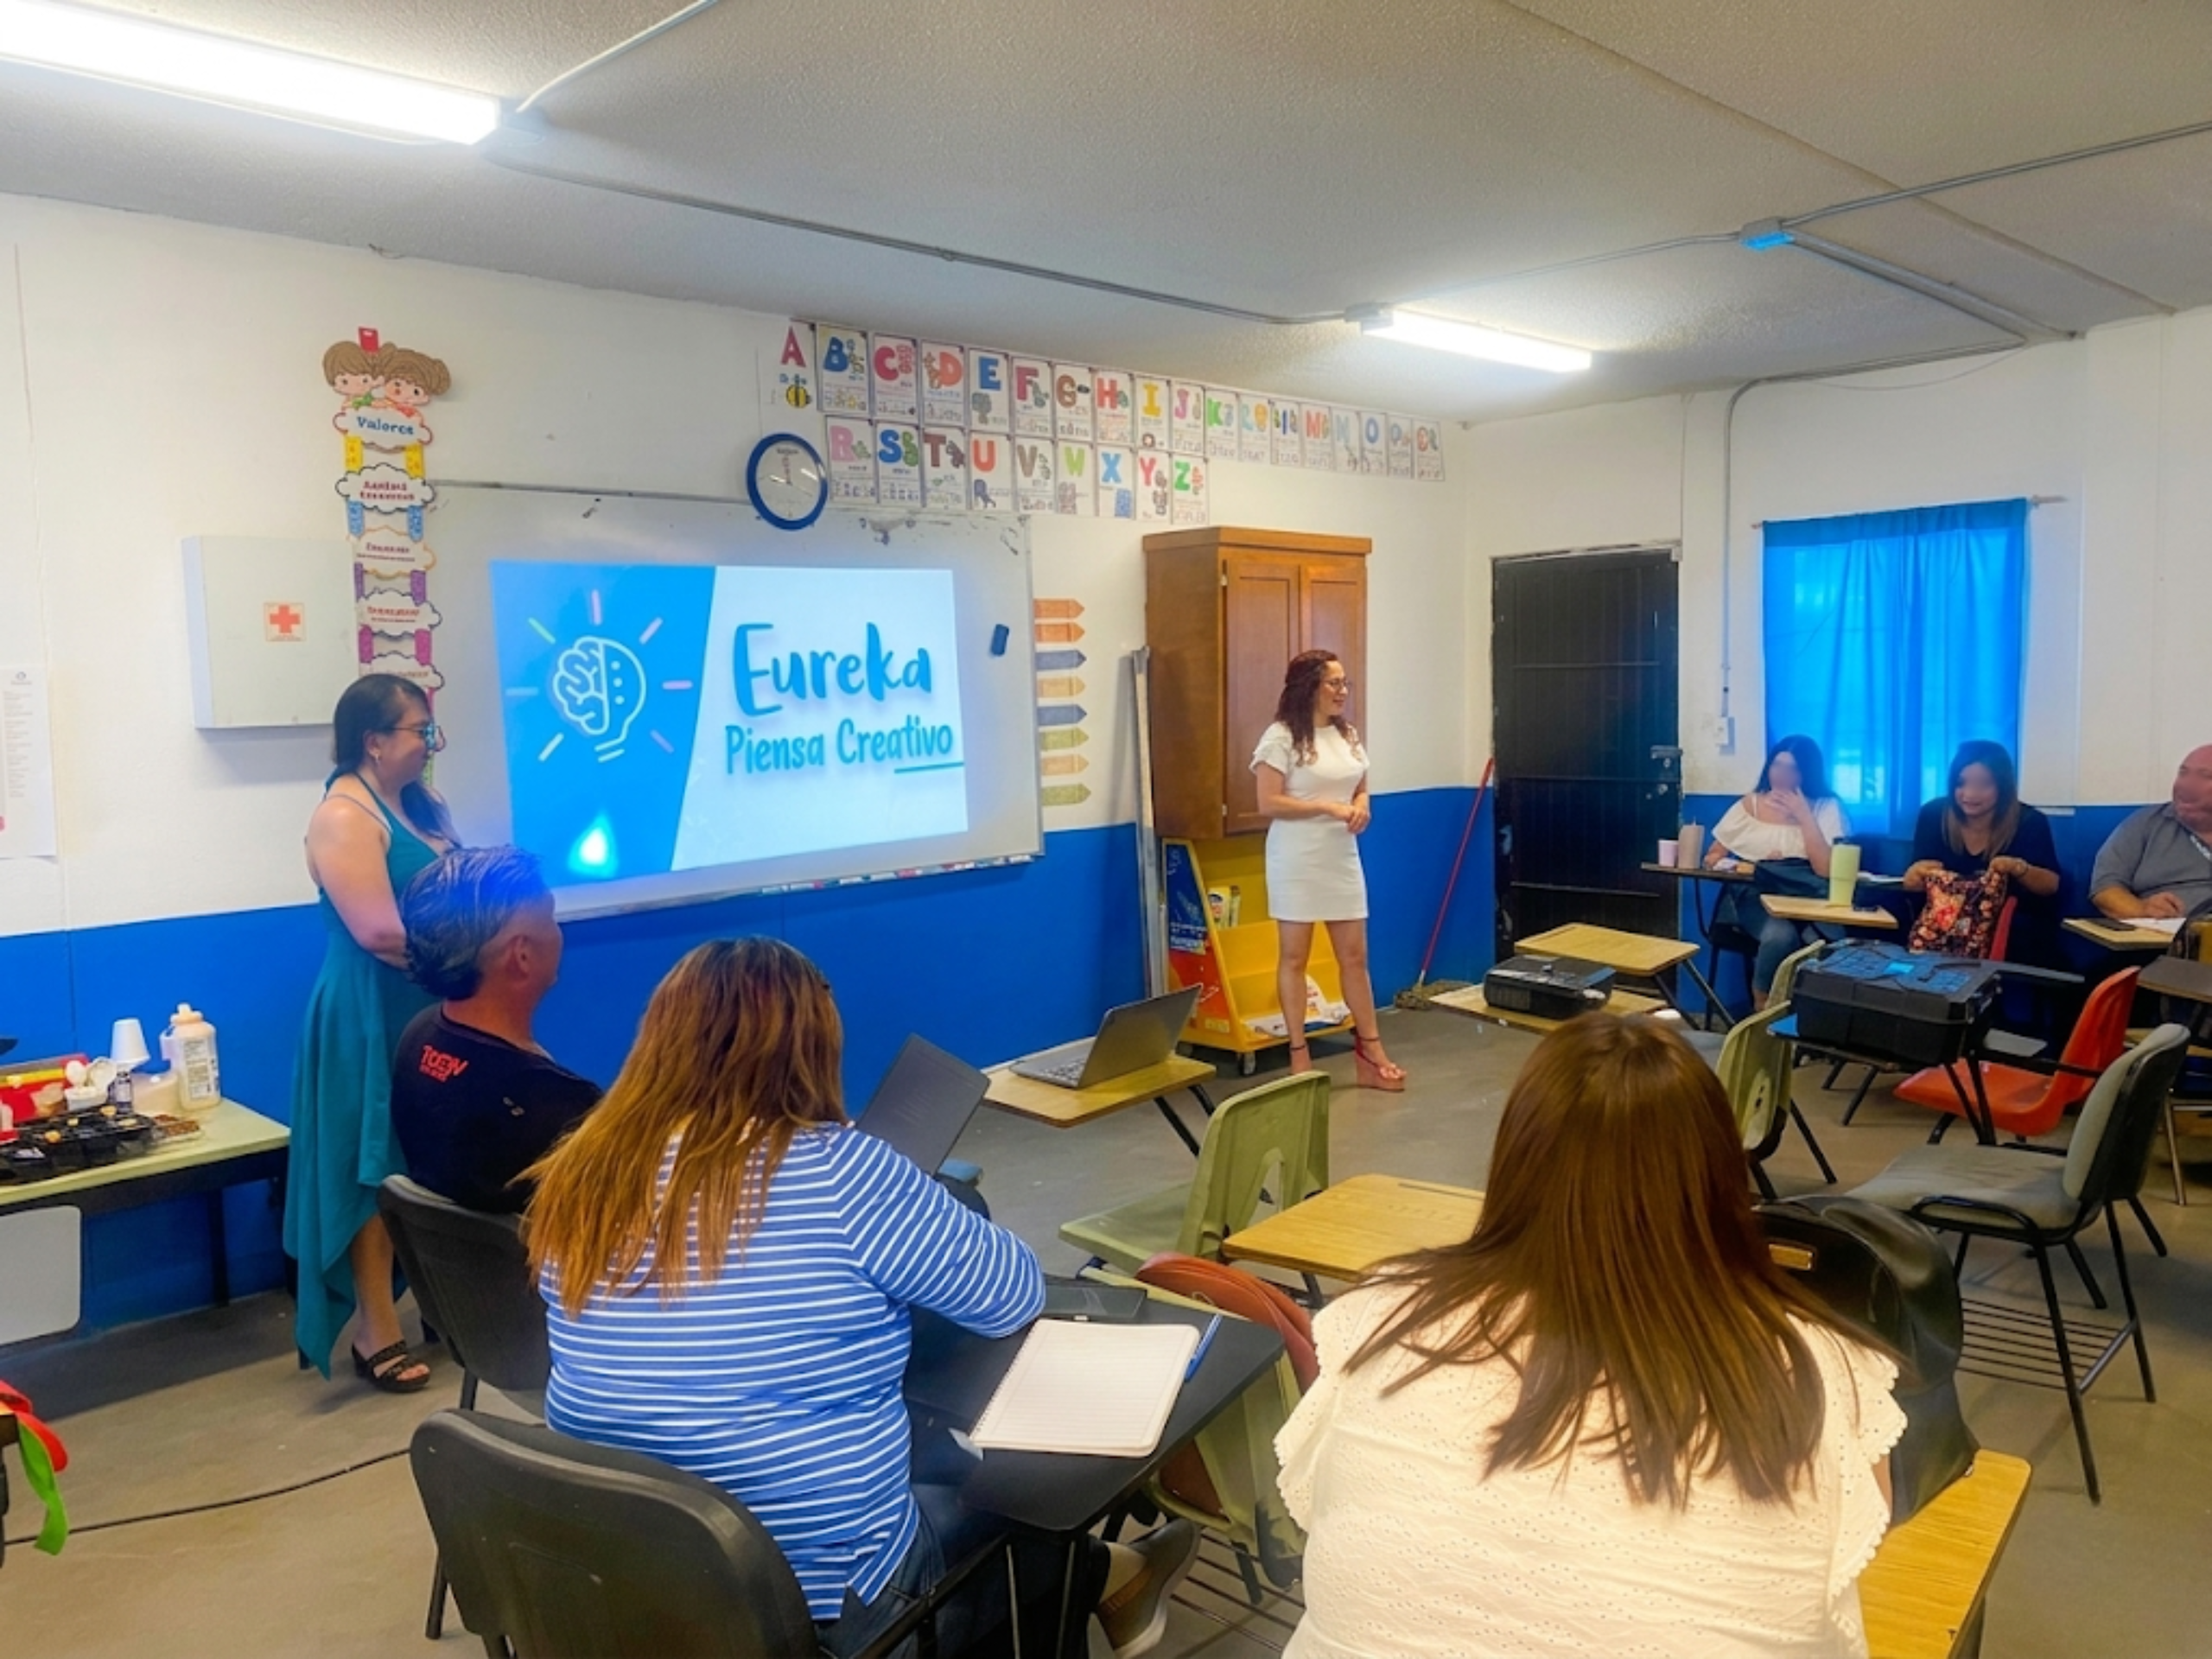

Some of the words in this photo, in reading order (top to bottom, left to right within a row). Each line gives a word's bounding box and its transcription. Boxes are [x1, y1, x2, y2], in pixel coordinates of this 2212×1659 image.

[781, 326, 806, 367] A
[823, 336, 849, 372] B
[874, 346, 899, 381] C
[939, 352, 963, 386] D
[978, 356, 1001, 391] E
[1015, 365, 1039, 401] F
[1096, 378, 1118, 410] H
[1142, 382, 1161, 418] I
[1175, 388, 1189, 419] J
[1207, 397, 1224, 427] K
[830, 425, 857, 461] R
[878, 429, 902, 463] S
[923, 433, 946, 467] T
[973, 439, 995, 473] U
[1017, 444, 1038, 478] V
[1101, 452, 1122, 483] X
[1139, 457, 1156, 486] Y
[1175, 461, 1191, 491] Z
[733, 622, 932, 717] Eureka
[725, 724, 824, 775] Piensa
[836, 714, 954, 765] Creativo
